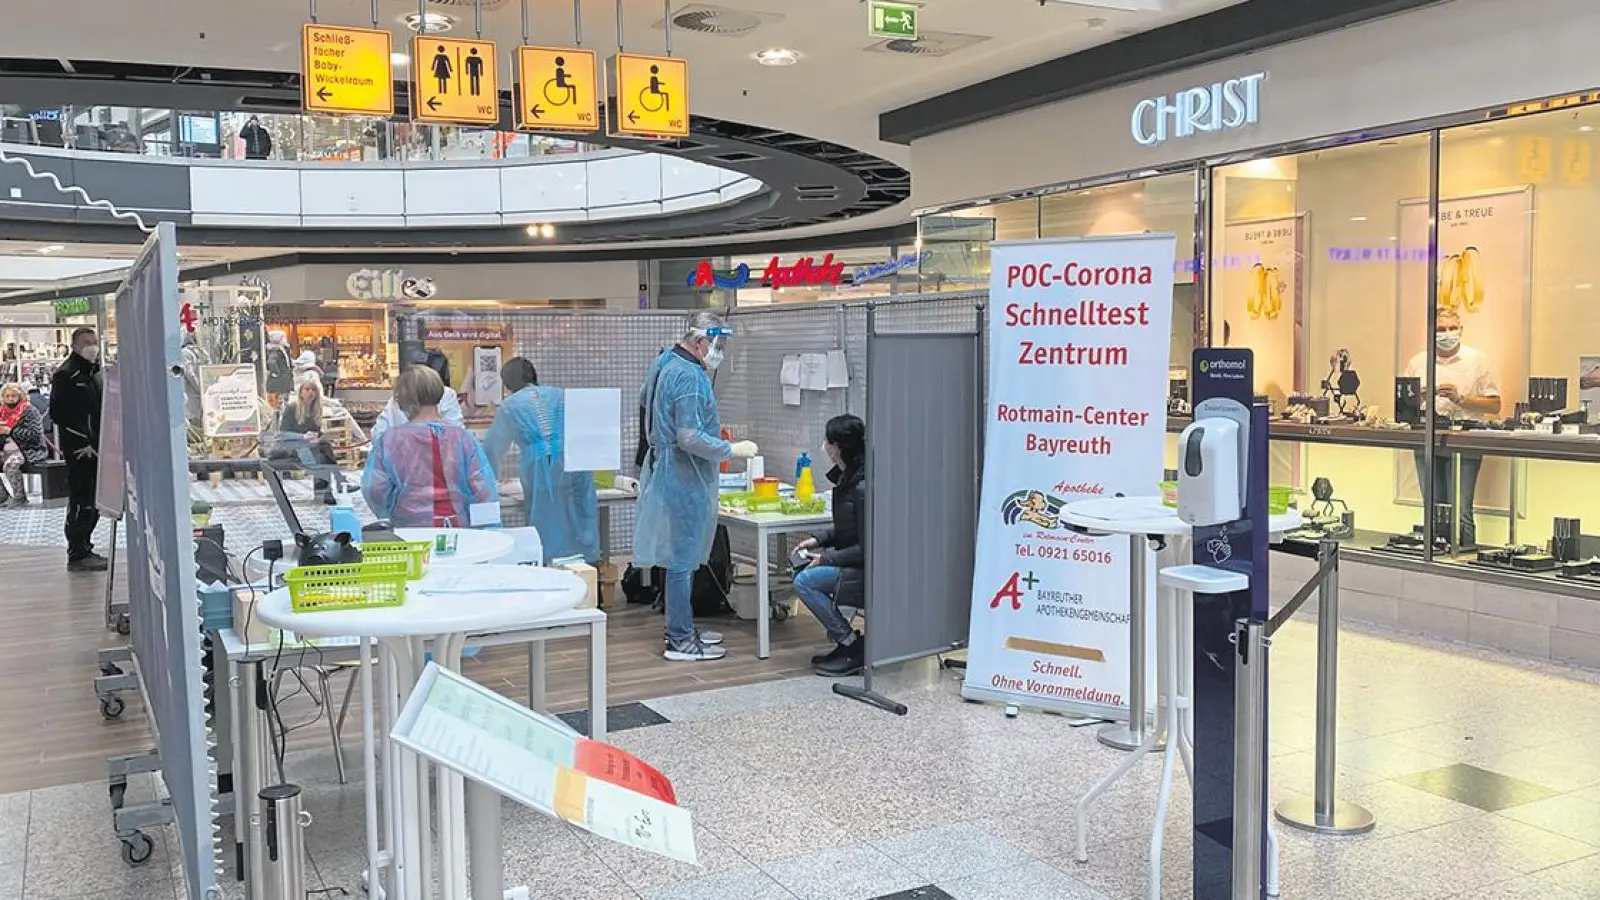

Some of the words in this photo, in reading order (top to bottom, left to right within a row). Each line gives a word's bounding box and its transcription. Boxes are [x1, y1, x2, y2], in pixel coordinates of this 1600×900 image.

[313, 32, 355, 45] Schließ-
[313, 60, 342, 72] Baby-
[315, 73, 374, 87] Wickelraum
[477, 105, 493, 116] WC
[577, 111, 593, 122] WC
[1131, 71, 1269, 146] CHRIST
[668, 119, 683, 129] WC
[1455, 209, 1462, 219] &
[1464, 206, 1493, 218] TREUE
[760, 252, 845, 290] Apotheke
[1007, 262, 1152, 288] POC-Corona
[1005, 301, 1150, 327] Schnelltest
[1019, 342, 1128, 365] Zentrum
[1209, 359, 1247, 370] orthomol
[997, 403, 1149, 427] Rotmain-Center
[1026, 433, 1111, 457] Bayreuth
[1052, 480, 1105, 495] Apotheke
[1015, 543, 1035, 557] Tel.
[1038, 545, 1068, 560] 0921
[1073, 549, 1112, 564] 65016
[1037, 589, 1084, 605] BAYREUTHER
[1032, 659, 1082, 679] Schnell.
[991, 674, 1024, 690] Ohne
[1026, 679, 1124, 707] Voranmeldung.
